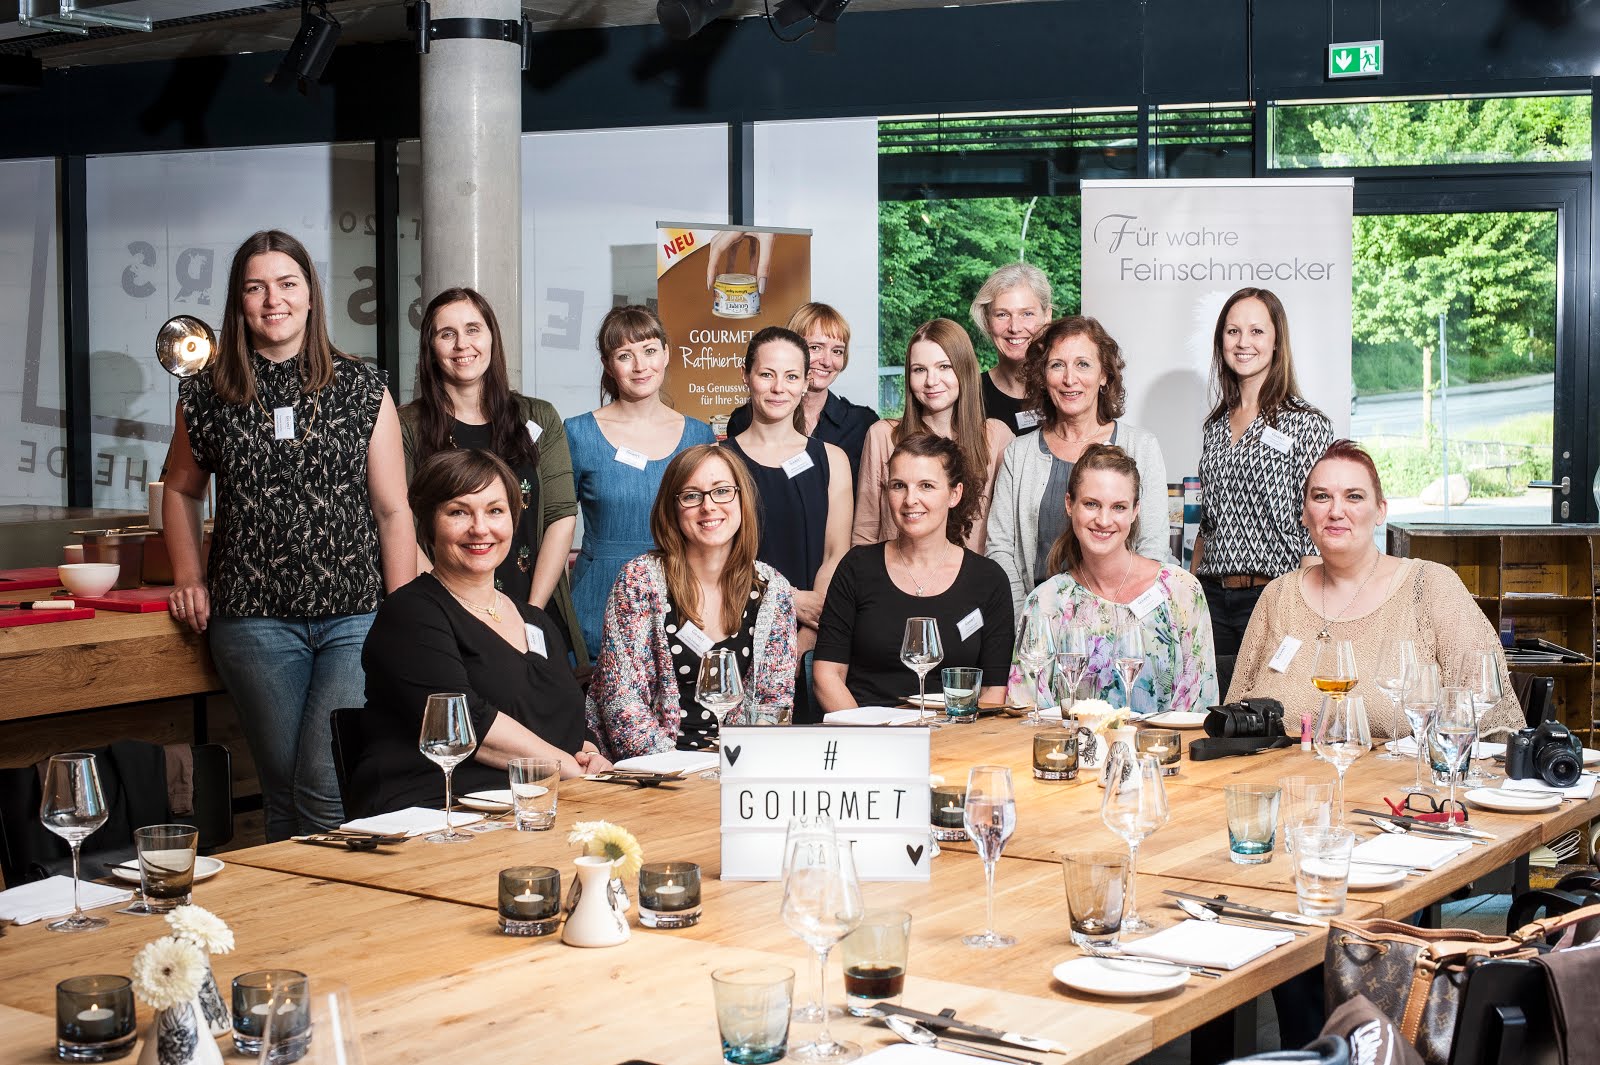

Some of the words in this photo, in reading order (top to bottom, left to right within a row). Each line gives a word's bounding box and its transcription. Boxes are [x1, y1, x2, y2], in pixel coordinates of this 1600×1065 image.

[663, 231, 696, 259] NEU
[1093, 213, 1159, 254] Für
[1166, 227, 1240, 246] wahre
[1120, 257, 1336, 281] Feinschmecker
[689, 329, 755, 345] GOURMET
[688, 383, 705, 394] Das
[701, 395, 712, 405] für
[714, 395, 732, 405] Ihre
[739, 789, 907, 821] GOURMET
